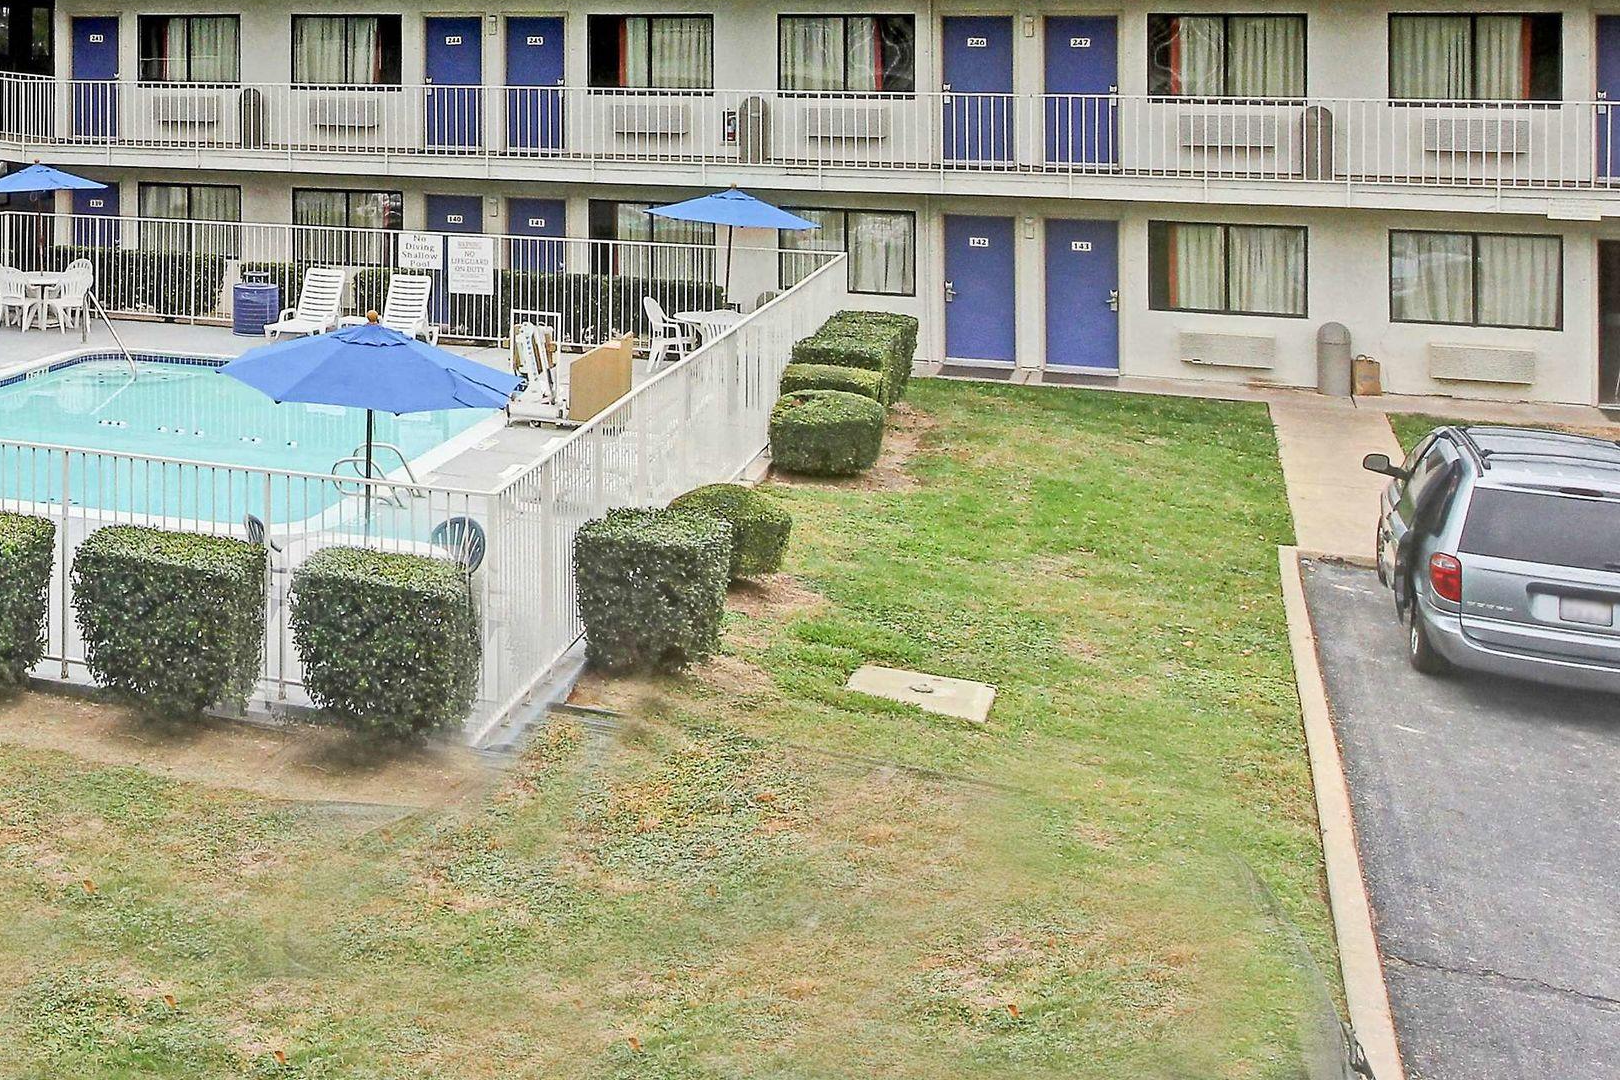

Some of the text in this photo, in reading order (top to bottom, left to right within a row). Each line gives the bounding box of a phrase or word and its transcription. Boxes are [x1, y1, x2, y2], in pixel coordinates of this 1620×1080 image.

[972, 238, 987, 246] 142
[1074, 242, 1090, 250] 143
[406, 243, 434, 252] Diving
[402, 252, 437, 260] Shallow
